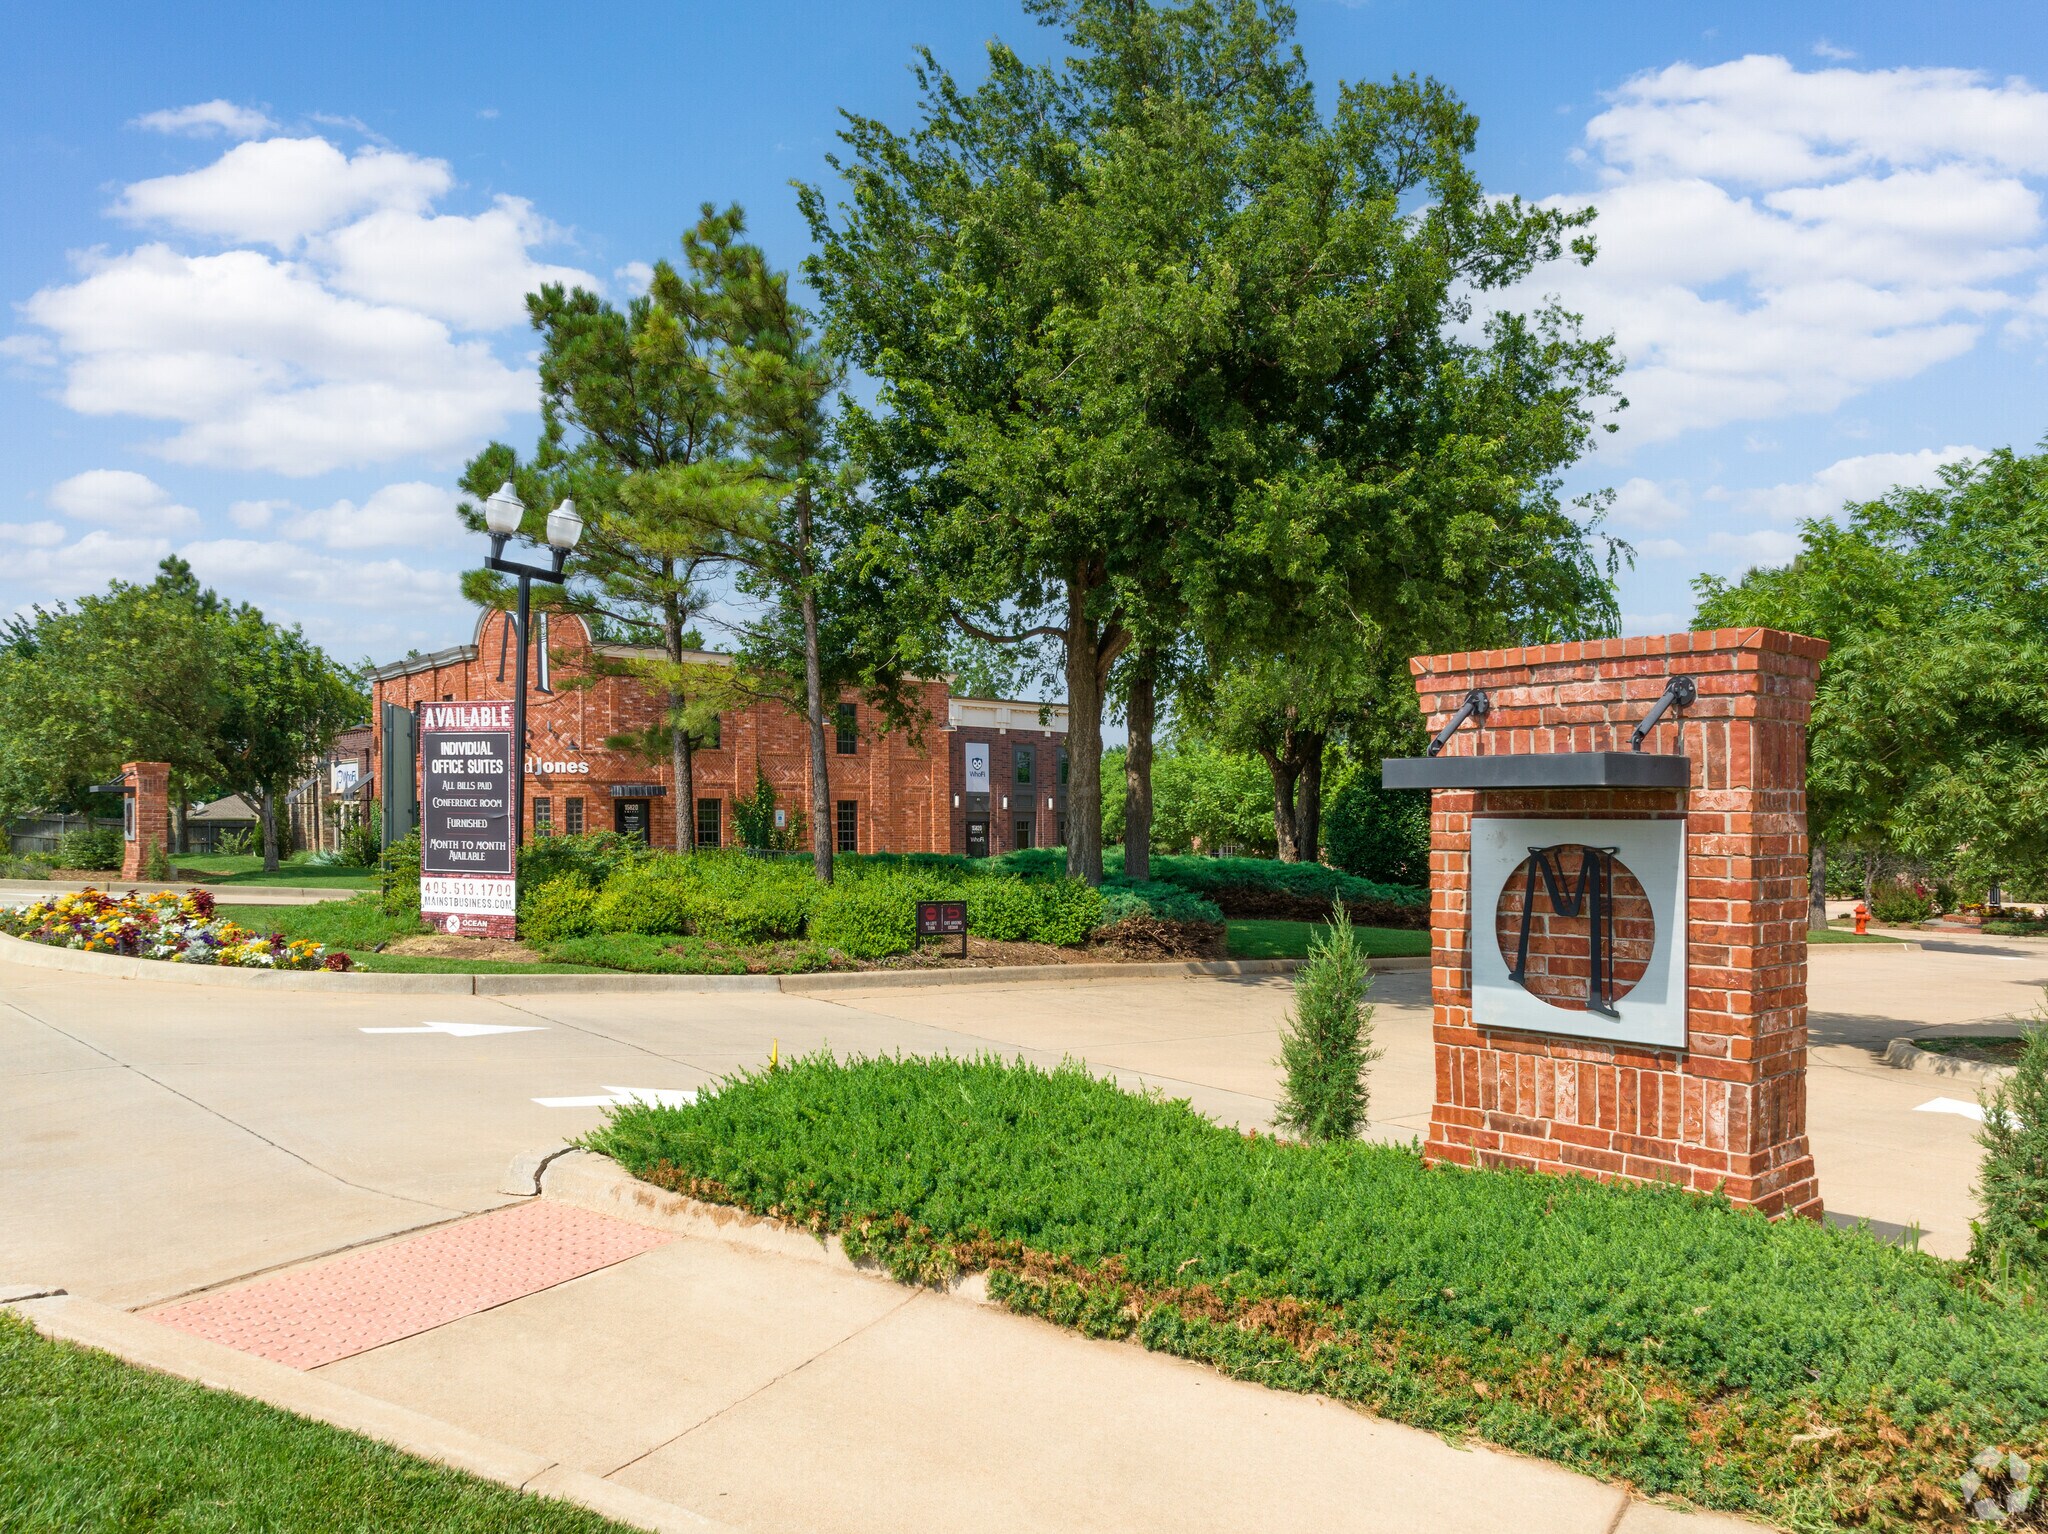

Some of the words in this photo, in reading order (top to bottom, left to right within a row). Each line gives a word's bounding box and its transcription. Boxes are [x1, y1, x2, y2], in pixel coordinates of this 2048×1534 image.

[425, 706, 510, 728] AVAILABLE
[440, 741, 493, 755] INDIVIDUAL
[431, 759, 464, 774] OFFICE
[467, 759, 504, 774] SUITES
[535, 757, 589, 775] Jones
[442, 781, 455, 791] ALL
[457, 782, 475, 790] BILLS
[477, 782, 493, 790] PAID
[432, 797, 478, 808] CONFERENCE
[479, 799, 503, 807] ROOM
[446, 817, 488, 829] FURNISHED
[430, 839, 459, 850] MONTH
[461, 840, 474, 849] TO
[475, 841, 506, 850] MONTH
[448, 850, 486, 861] AVAILABLE
[425, 882, 511, 896] 405.513.1700
[424, 896, 512, 909] MAINSTBUSINESS.COM
[1508, 845, 1620, 1018] M
